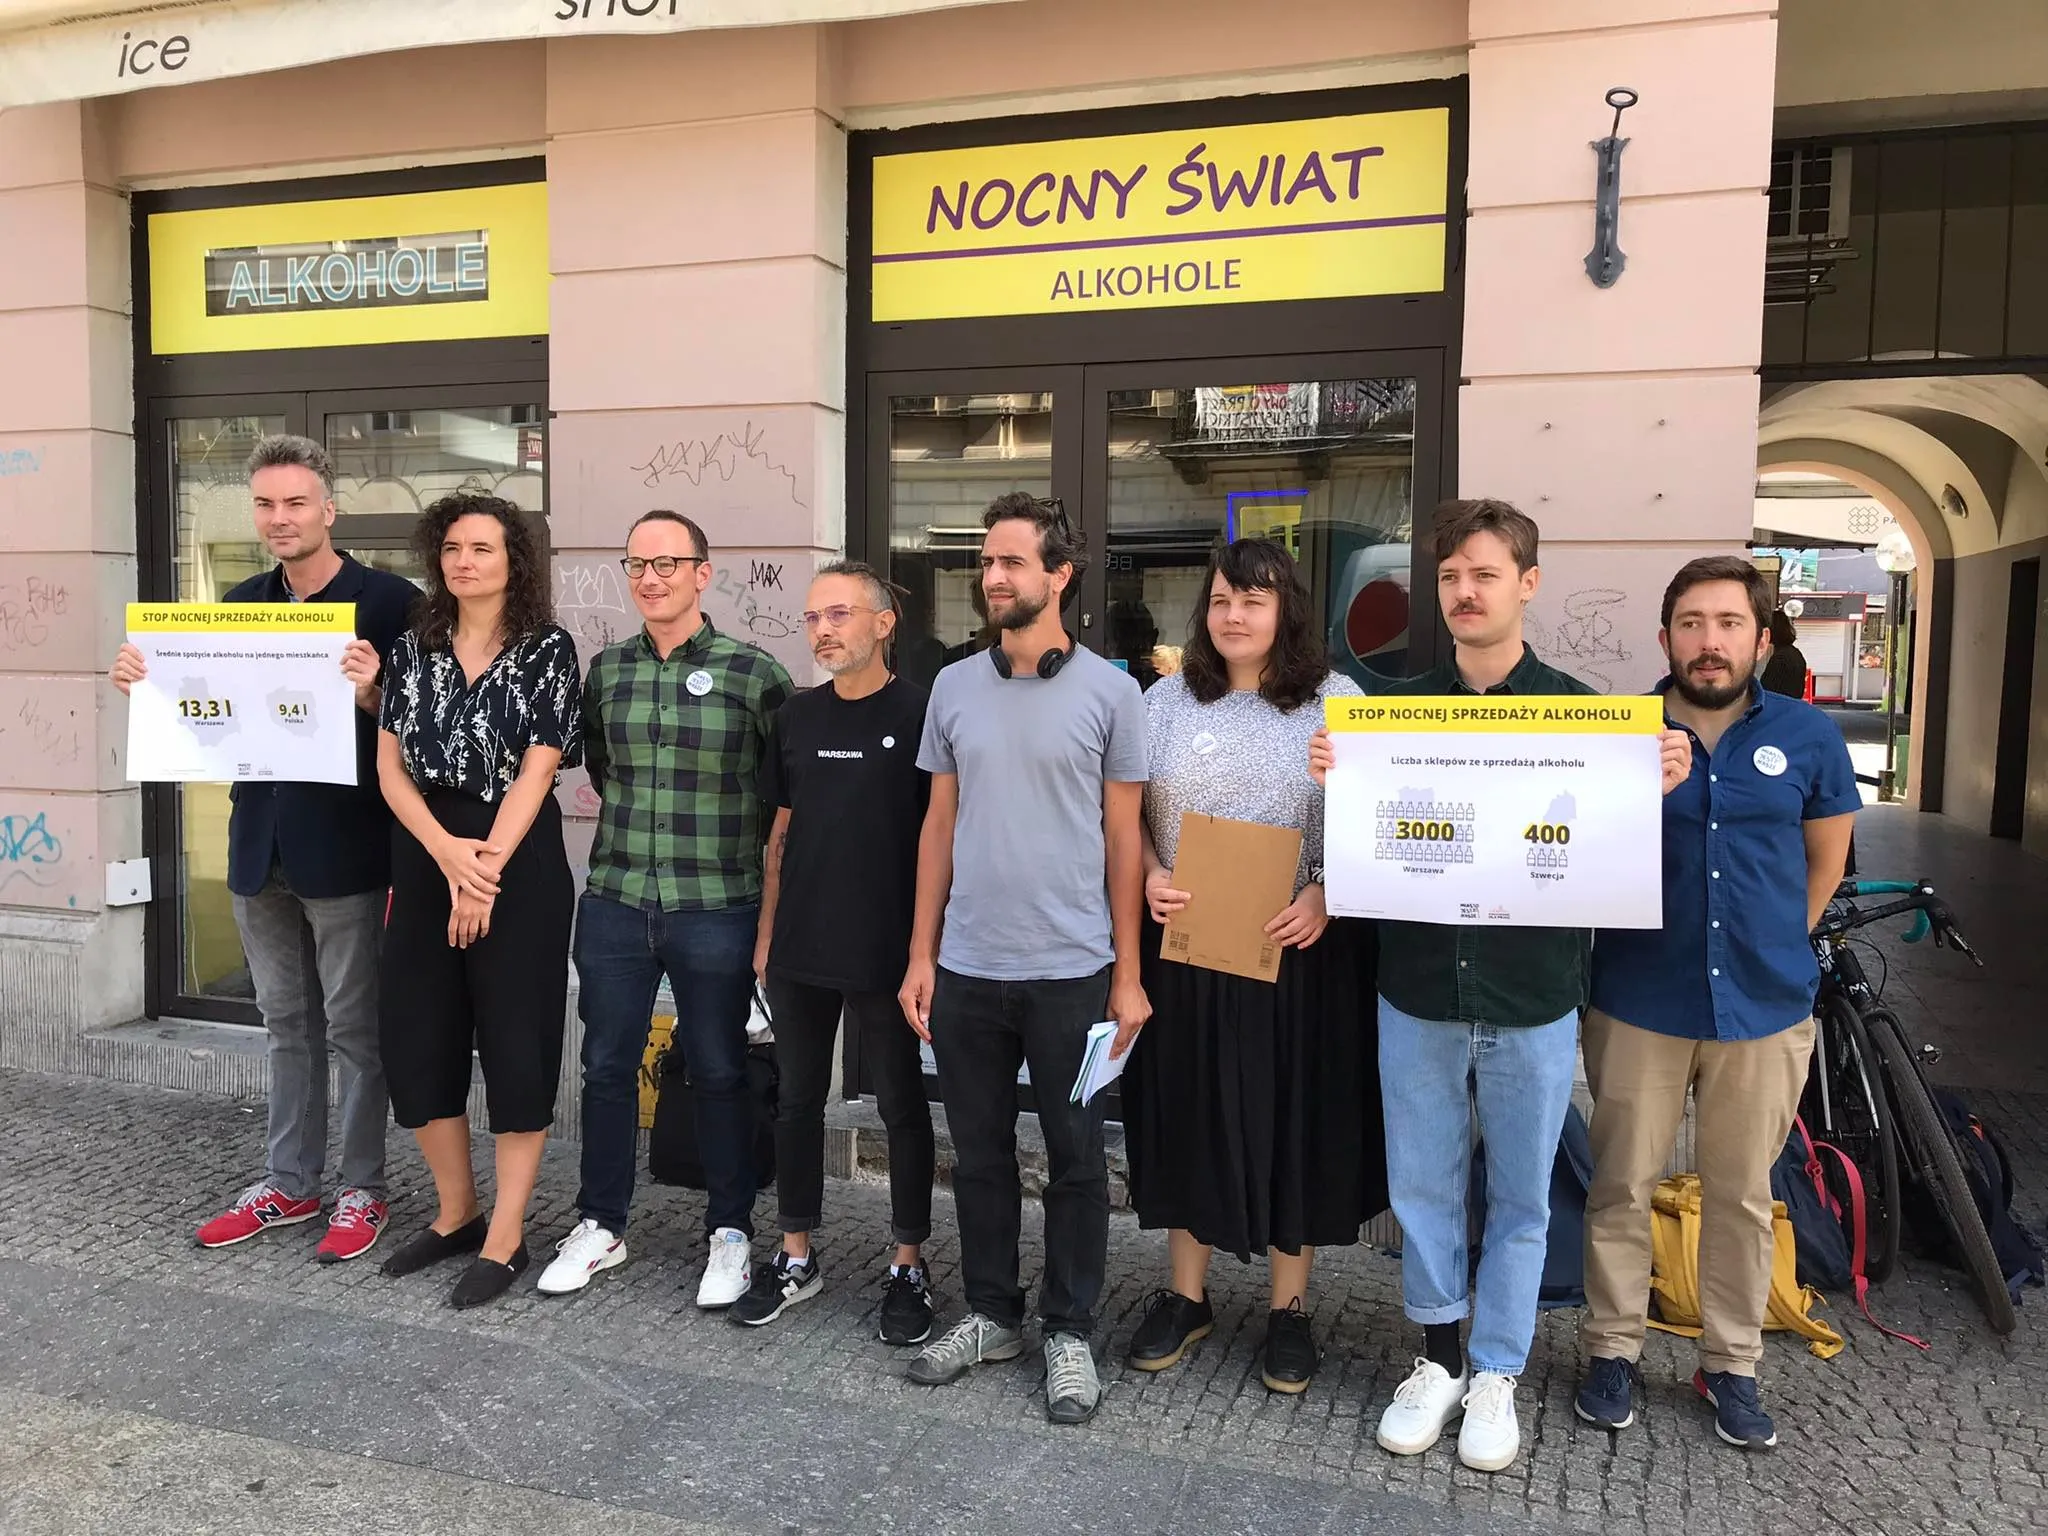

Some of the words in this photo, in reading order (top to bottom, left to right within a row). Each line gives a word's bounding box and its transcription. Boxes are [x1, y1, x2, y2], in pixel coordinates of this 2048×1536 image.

[117, 31, 191, 77] ice
[926, 163, 1148, 234] NOCNY
[1165, 142, 1384, 216] ŚWIAT
[224, 242, 487, 309] ALKOHOLE
[1050, 258, 1242, 300] ALKOHOLE
[143, 613, 169, 621] STOP
[171, 613, 211, 624] NOCNEJ
[214, 610, 272, 622] SPRZEDAŻY
[275, 613, 334, 622] ALKOHOLU
[255, 651, 284, 660] jednego
[179, 700, 220, 719] 13,3
[279, 705, 300, 717] 9,4
[1349, 709, 1385, 720] STOP
[1390, 709, 1447, 722] NOCNEJ
[1451, 705, 1538, 720] SPRZEDAŻY
[1543, 709, 1632, 720] ALKOHOLU
[818, 750, 863, 759] WARSZAWA
[1391, 756, 1422, 765] Liczba
[1424, 757, 1466, 767] sklepów
[1483, 758, 1535, 769] sprzedażą
[1538, 759, 1585, 767] alkoholu
[1396, 821, 1454, 841] 3000
[1525, 825, 1570, 844] 400
[1403, 866, 1444, 874] Warszawa
[1530, 871, 1565, 880] Szwecja
